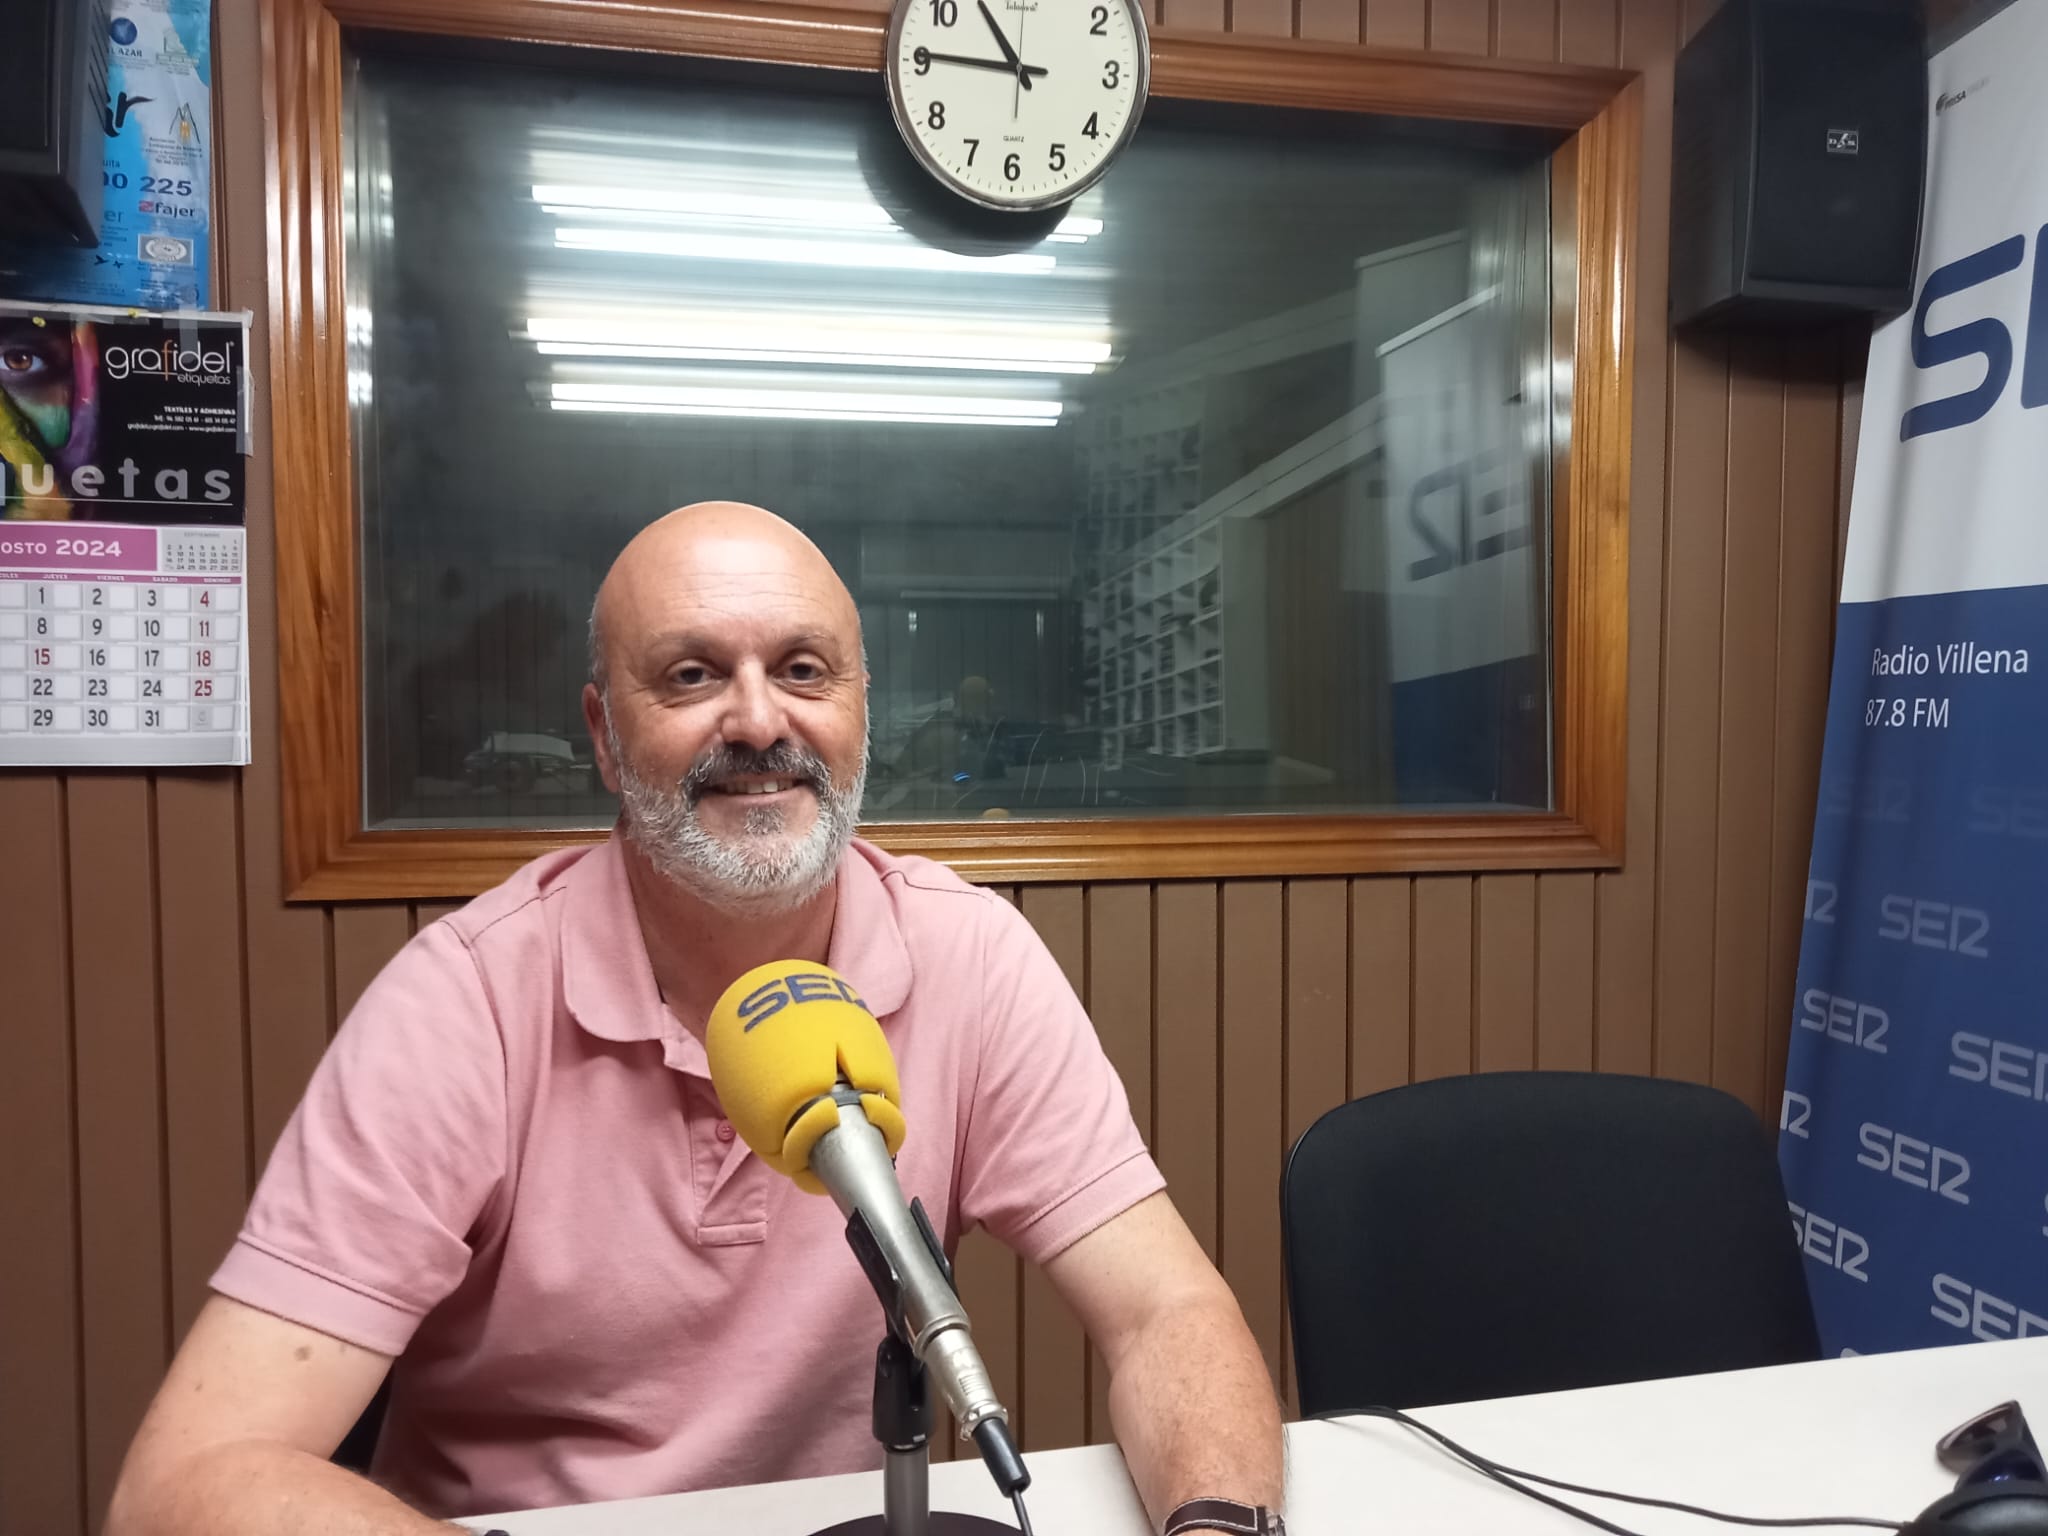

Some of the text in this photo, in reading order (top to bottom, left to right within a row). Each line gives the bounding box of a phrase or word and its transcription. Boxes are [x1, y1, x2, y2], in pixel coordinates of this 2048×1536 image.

[929, 0, 957, 27] 10
[1090, 6, 1108, 36] 2
[914, 46, 931, 76] 9
[1102, 60, 1120, 89] 3
[928, 101, 945, 130] 8
[1082, 112, 1099, 140] 4
[963, 139, 980, 167] 7
[1004, 153, 1021, 181] 6
[1048, 144, 1066, 171] 5
[139, 176, 192, 196] 225
[155, 202, 195, 218] fajer
[1901, 223, 2048, 442] S
[105, 339, 232, 381] grafidel
[177, 374, 231, 386] etiquetas
[0, 458, 232, 506] uetas
[1, 539, 122, 557] OSTO 2024
[39, 586, 209, 607] 1 2 3 4
[37, 617, 210, 637] 8 9 10 11
[34, 648, 212, 667] 15 16 17 18
[1872, 642, 2029, 676] Radio Villena
[33, 678, 212, 697] 22 23 24 25
[33, 709, 160, 727] 29 30 31
[1865, 698, 1949, 728] 87.8 FM
[1878, 893, 1990, 958] SER
[1801, 988, 1889, 1054] SER
[1857, 1122, 1970, 1205] SER
